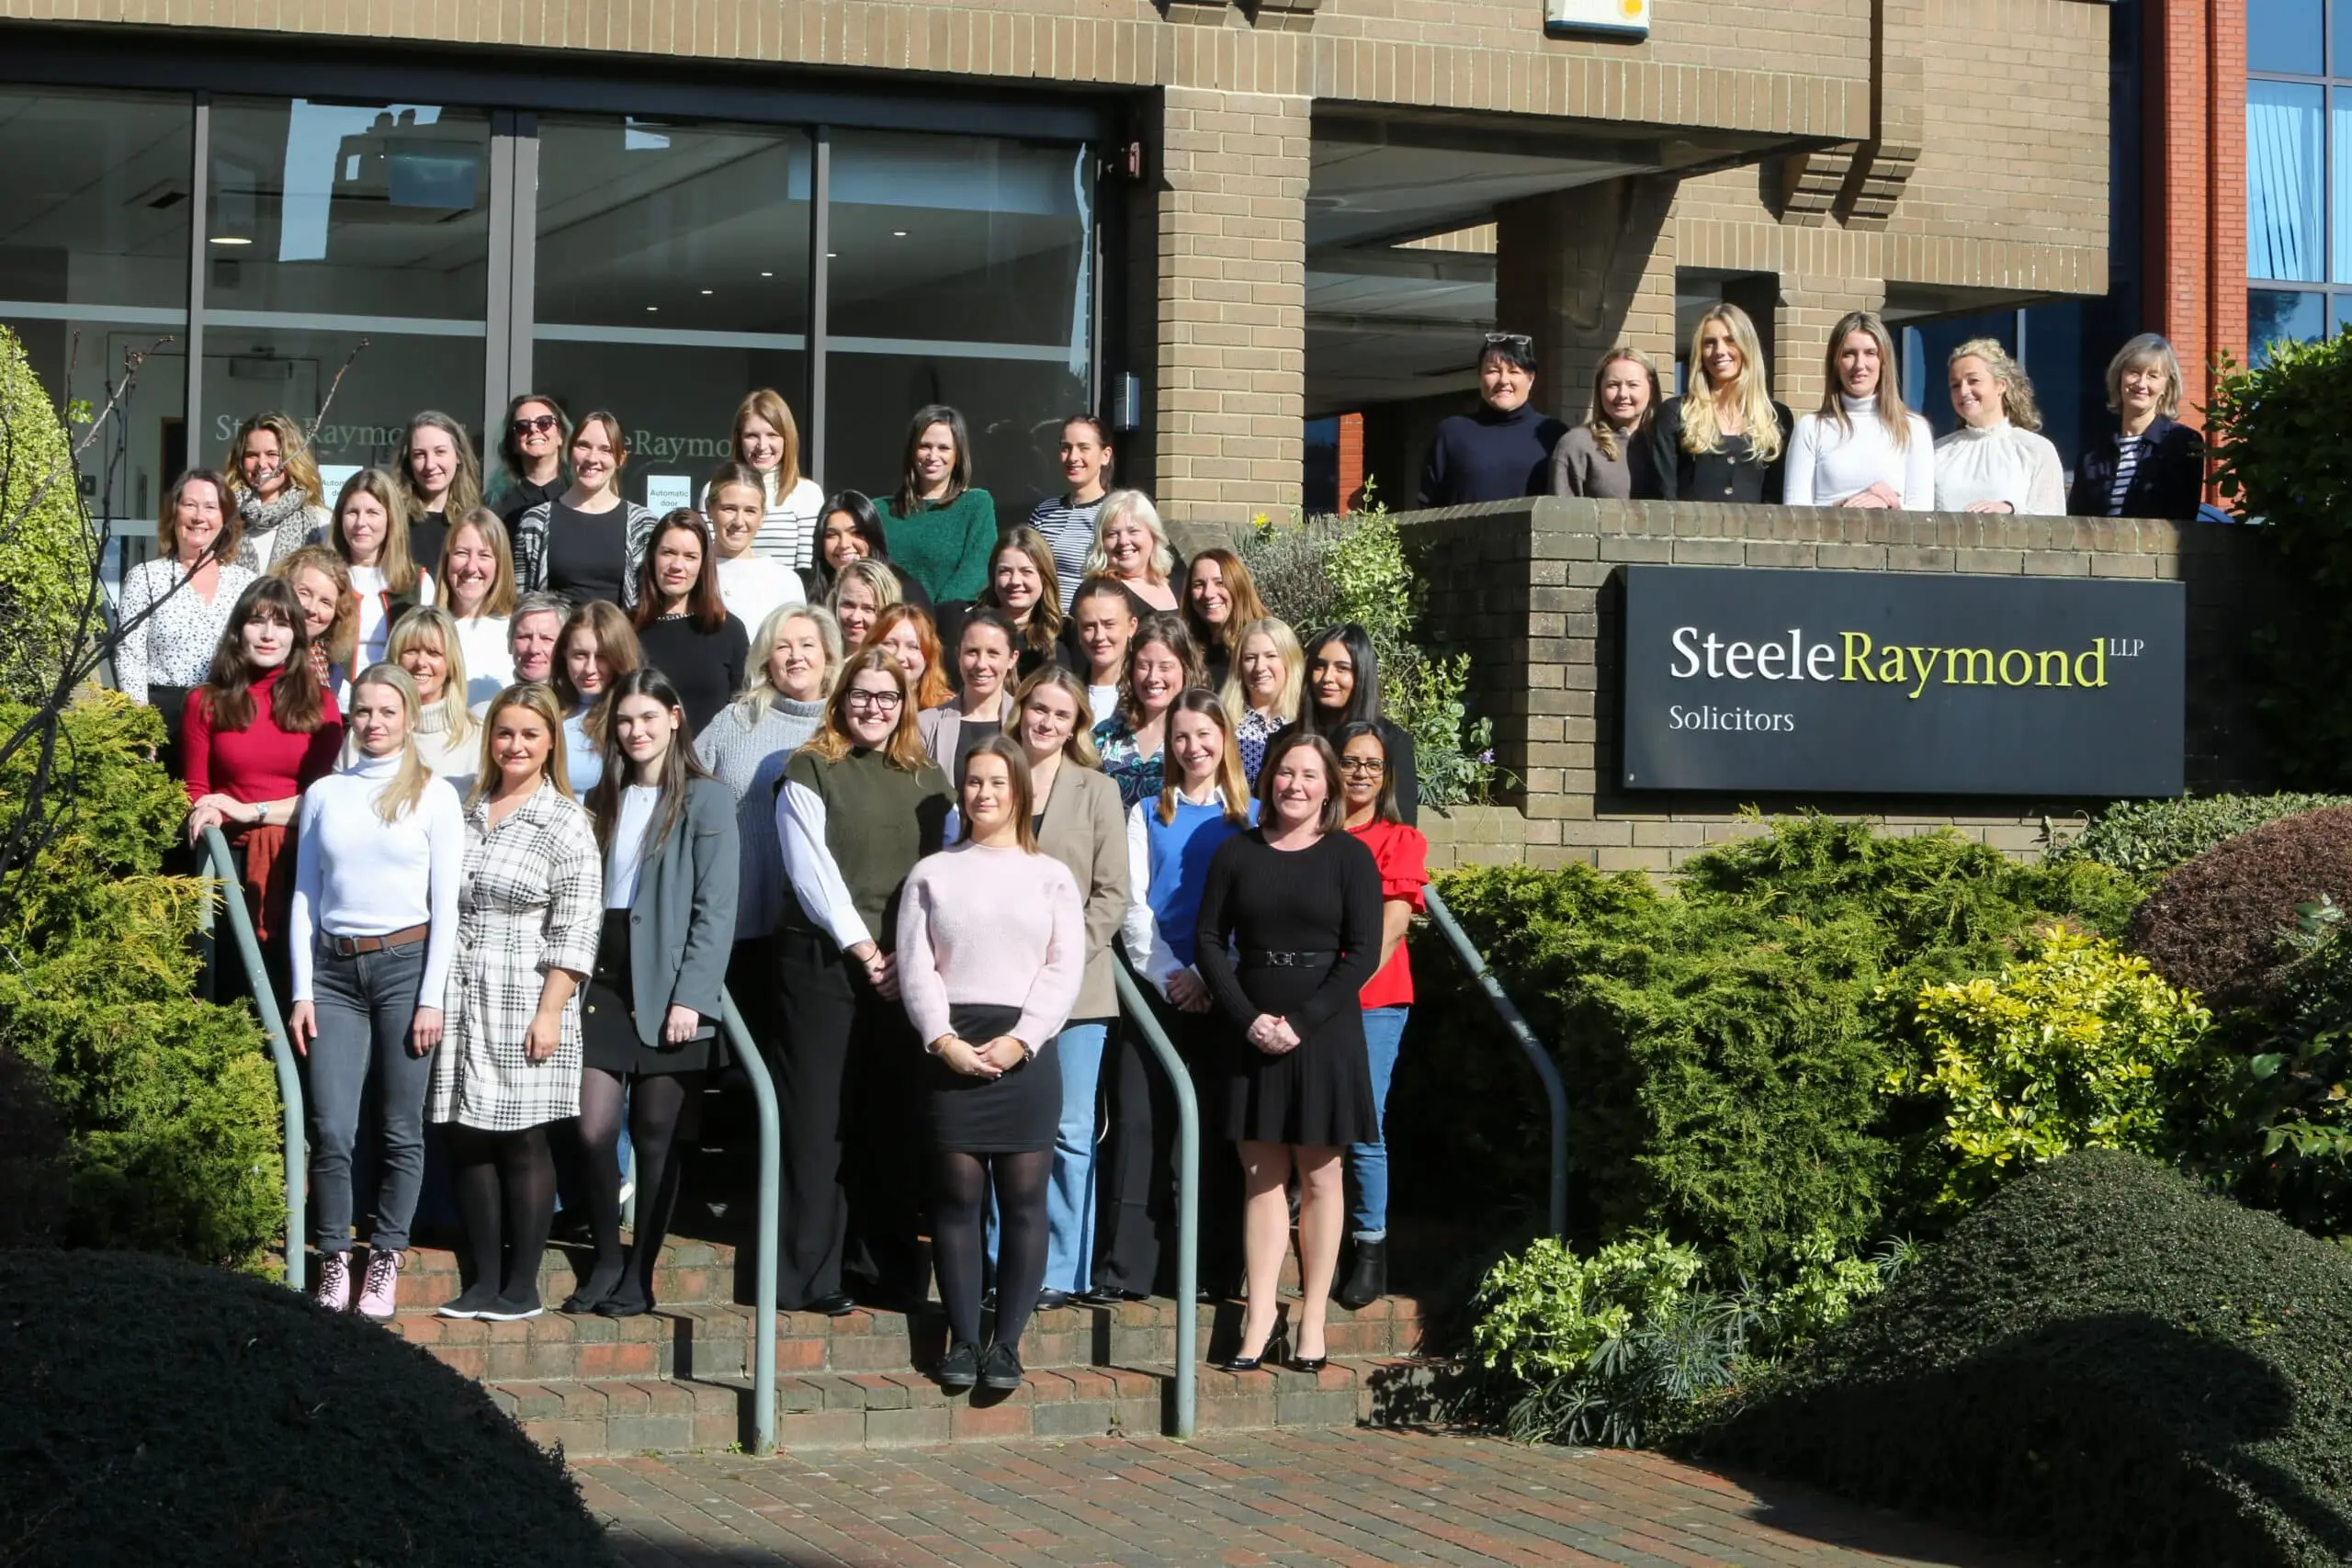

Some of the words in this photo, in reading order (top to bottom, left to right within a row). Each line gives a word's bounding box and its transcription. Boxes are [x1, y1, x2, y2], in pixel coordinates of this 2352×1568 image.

[661, 499, 678, 507] door
[2109, 637, 2144, 657] LLP
[1669, 705, 1794, 732] Solicitors
